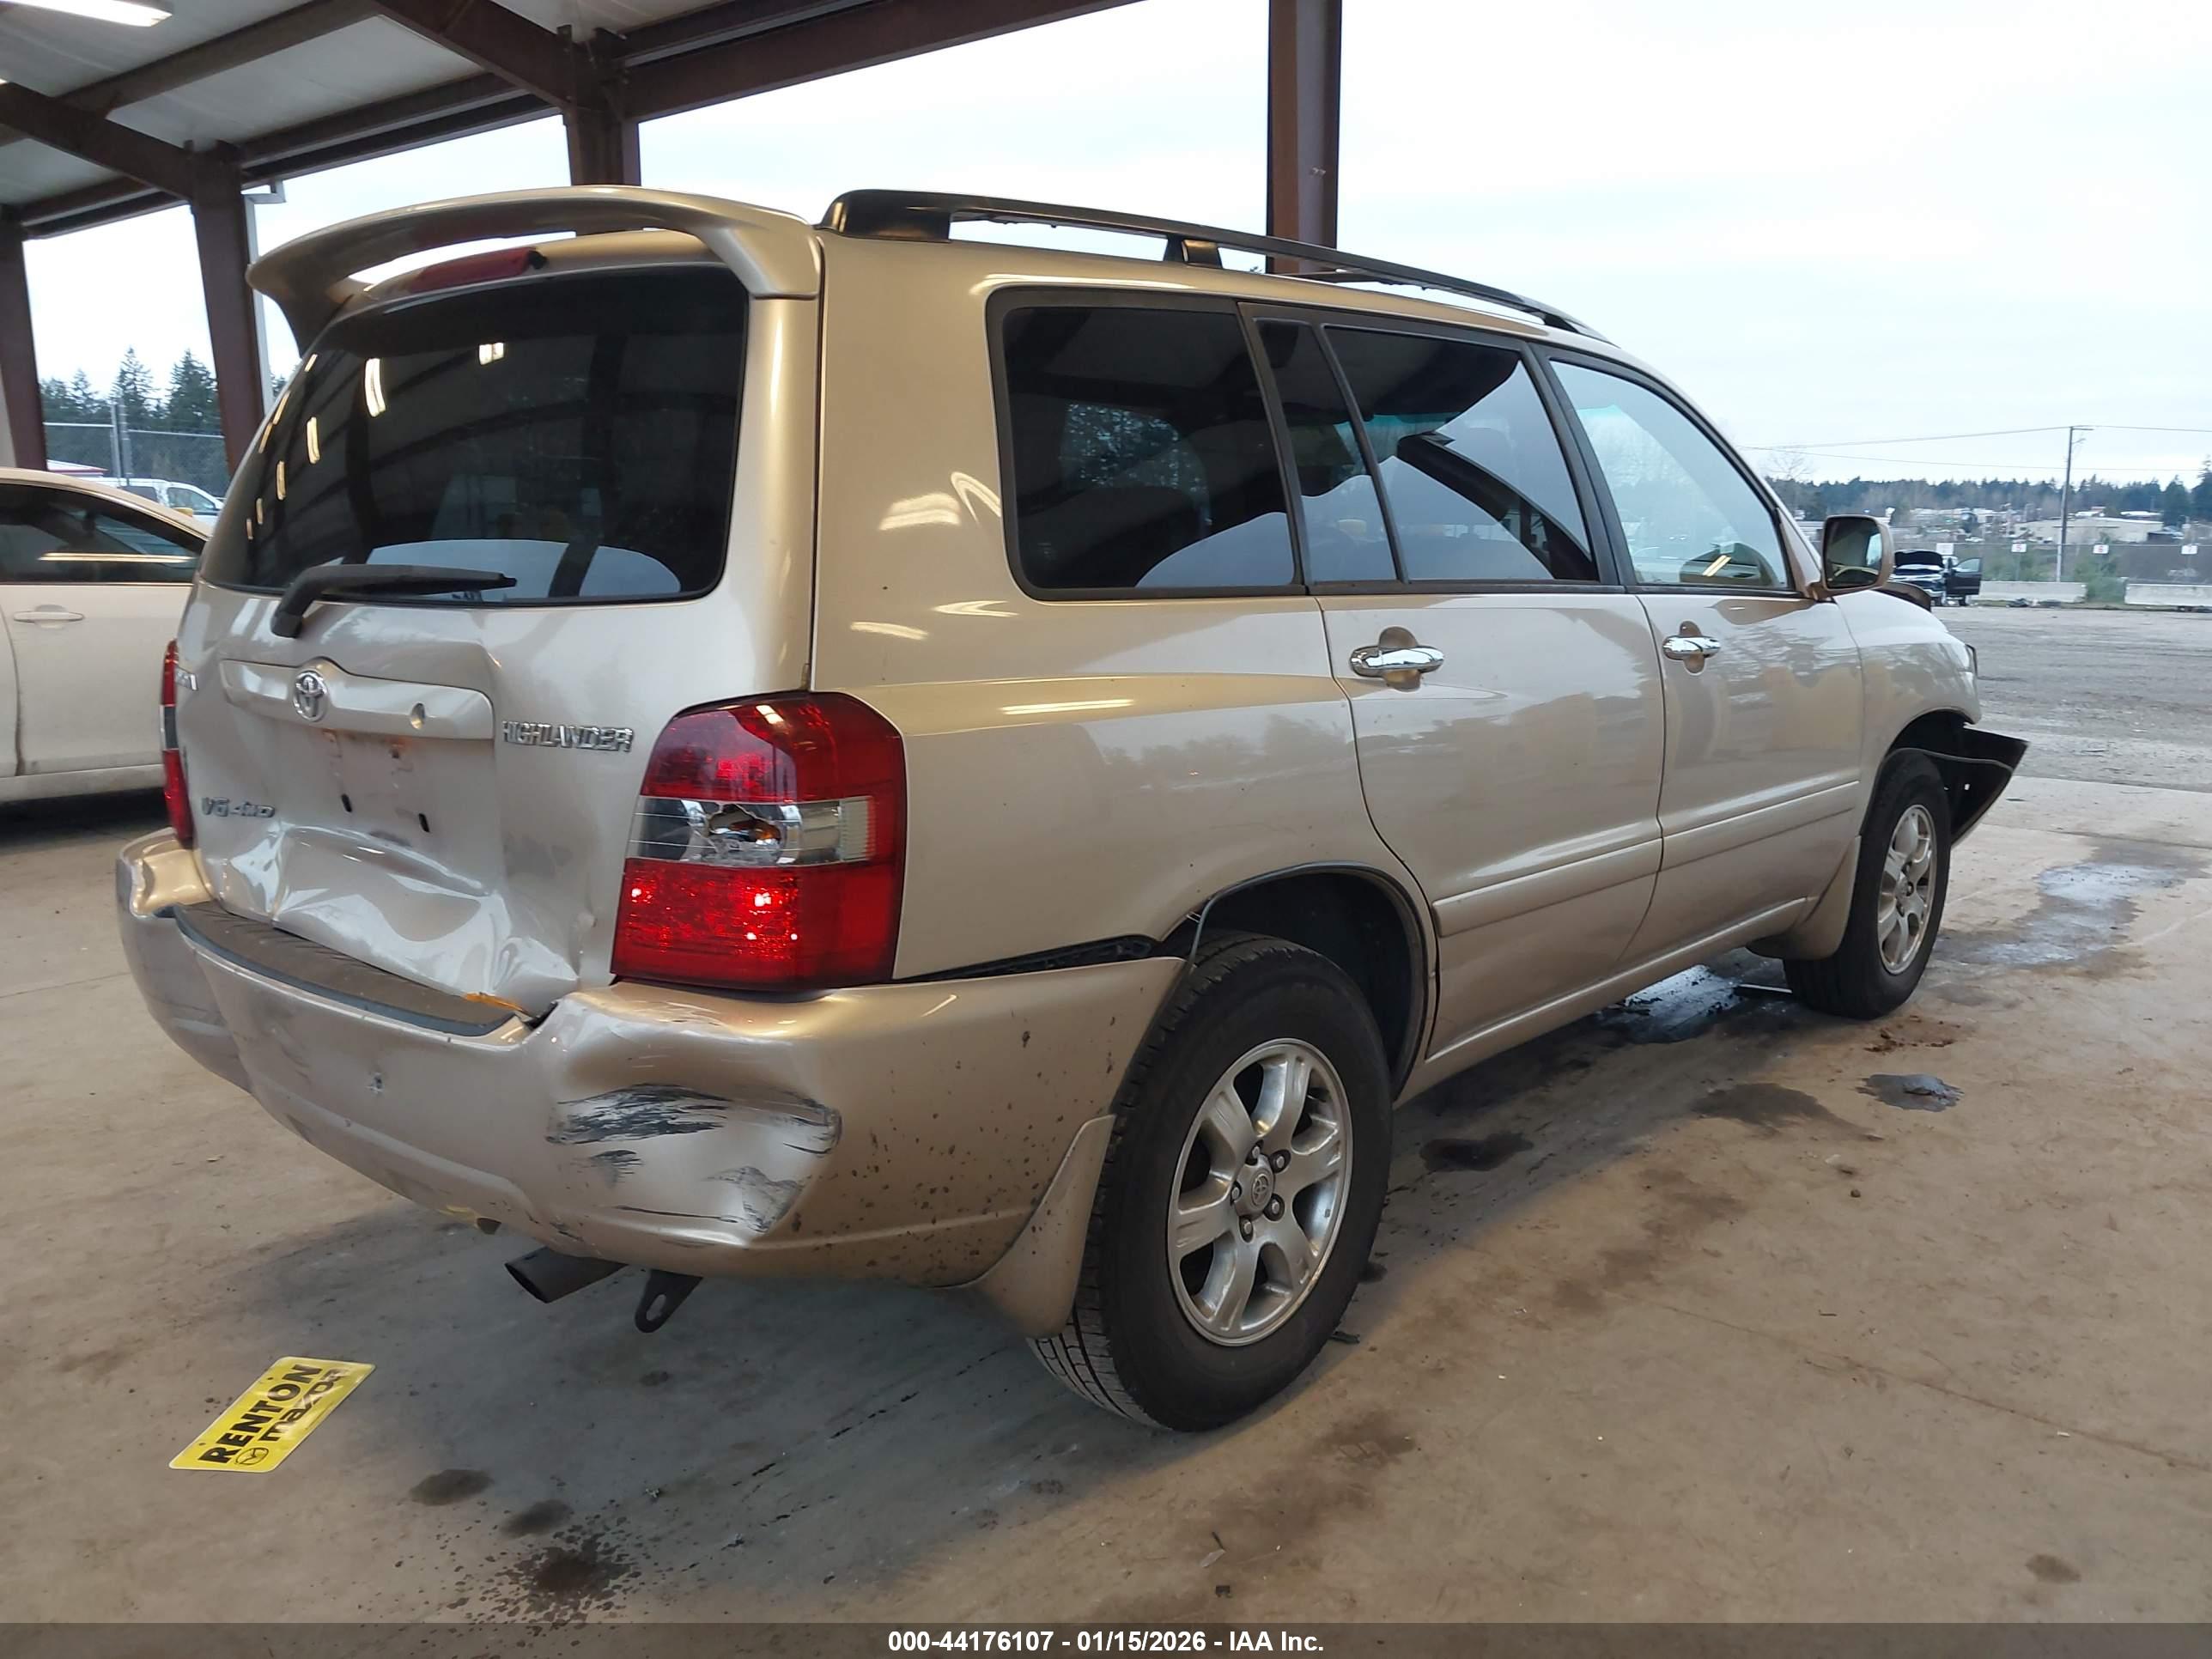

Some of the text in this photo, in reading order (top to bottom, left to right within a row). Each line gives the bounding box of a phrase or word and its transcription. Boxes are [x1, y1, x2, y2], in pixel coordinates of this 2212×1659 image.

[502, 720, 634, 752] HIGHLANDER
[202, 796, 229, 817] V6
[198, 1364, 323, 1463] RENTON
